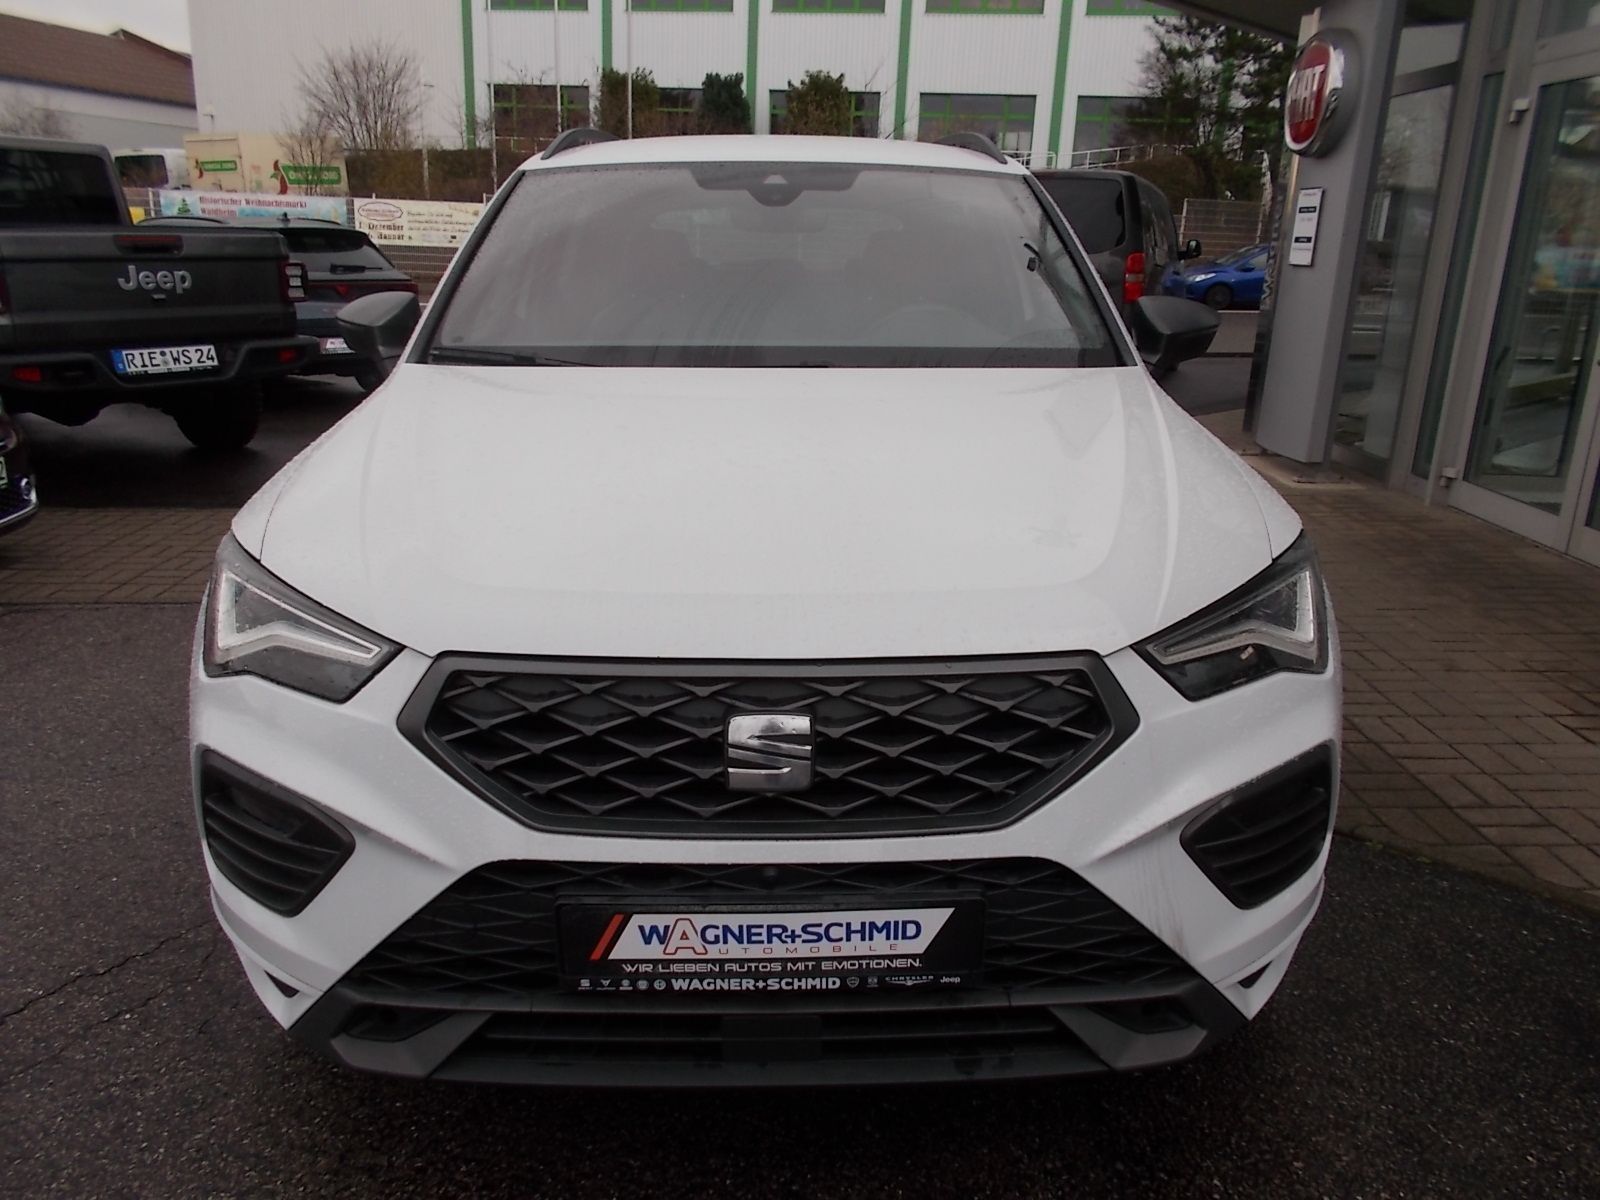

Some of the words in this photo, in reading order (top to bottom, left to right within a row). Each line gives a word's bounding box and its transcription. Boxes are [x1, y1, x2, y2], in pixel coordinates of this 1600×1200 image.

[117, 264, 193, 294] Jeep
[124, 352, 161, 370] RIE
[169, 348, 193, 367] WS
[194, 347, 216, 365] 24
[638, 918, 922, 955] WAGNER+SCHMID
[621, 963, 653, 973] WIR
[659, 963, 720, 973] LIEBEN
[725, 962, 783, 972] AUTOS
[787, 961, 817, 971] MIT
[821, 958, 923, 971] EMOTIONEN.
[671, 977, 841, 991] WAGNER+SCHMID
[940, 976, 961, 984] Jeep
